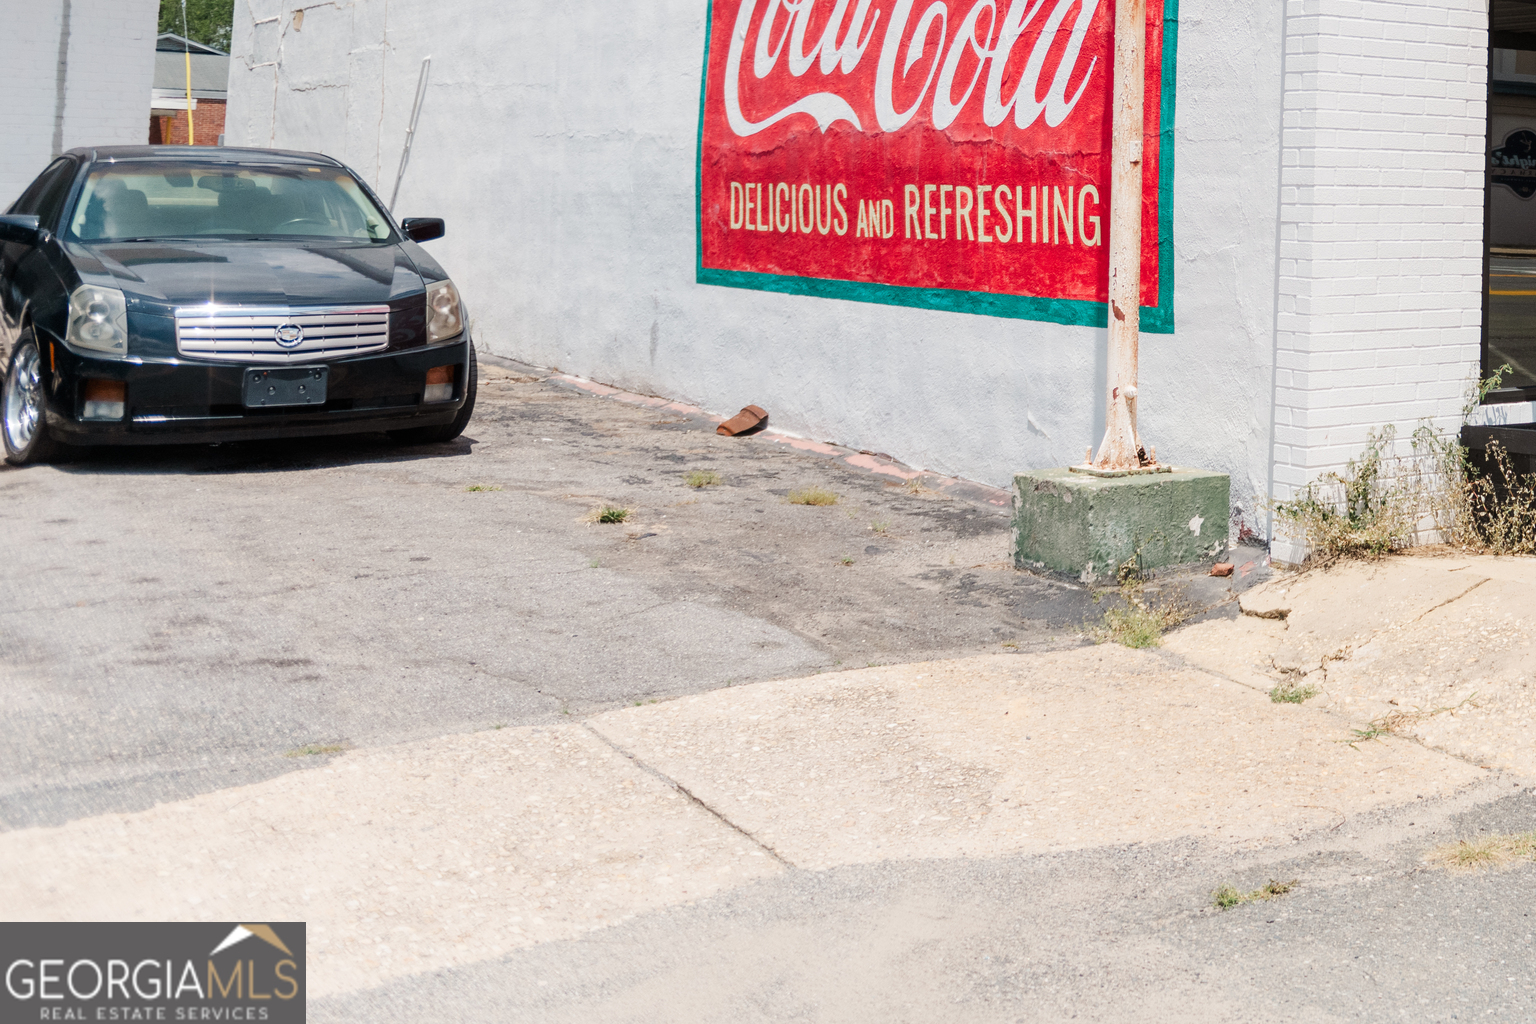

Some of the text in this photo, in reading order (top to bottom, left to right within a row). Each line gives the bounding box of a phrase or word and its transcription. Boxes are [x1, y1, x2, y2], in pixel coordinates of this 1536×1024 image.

[729, 181, 1102, 247] DELICIOUS AND REFRESHING
